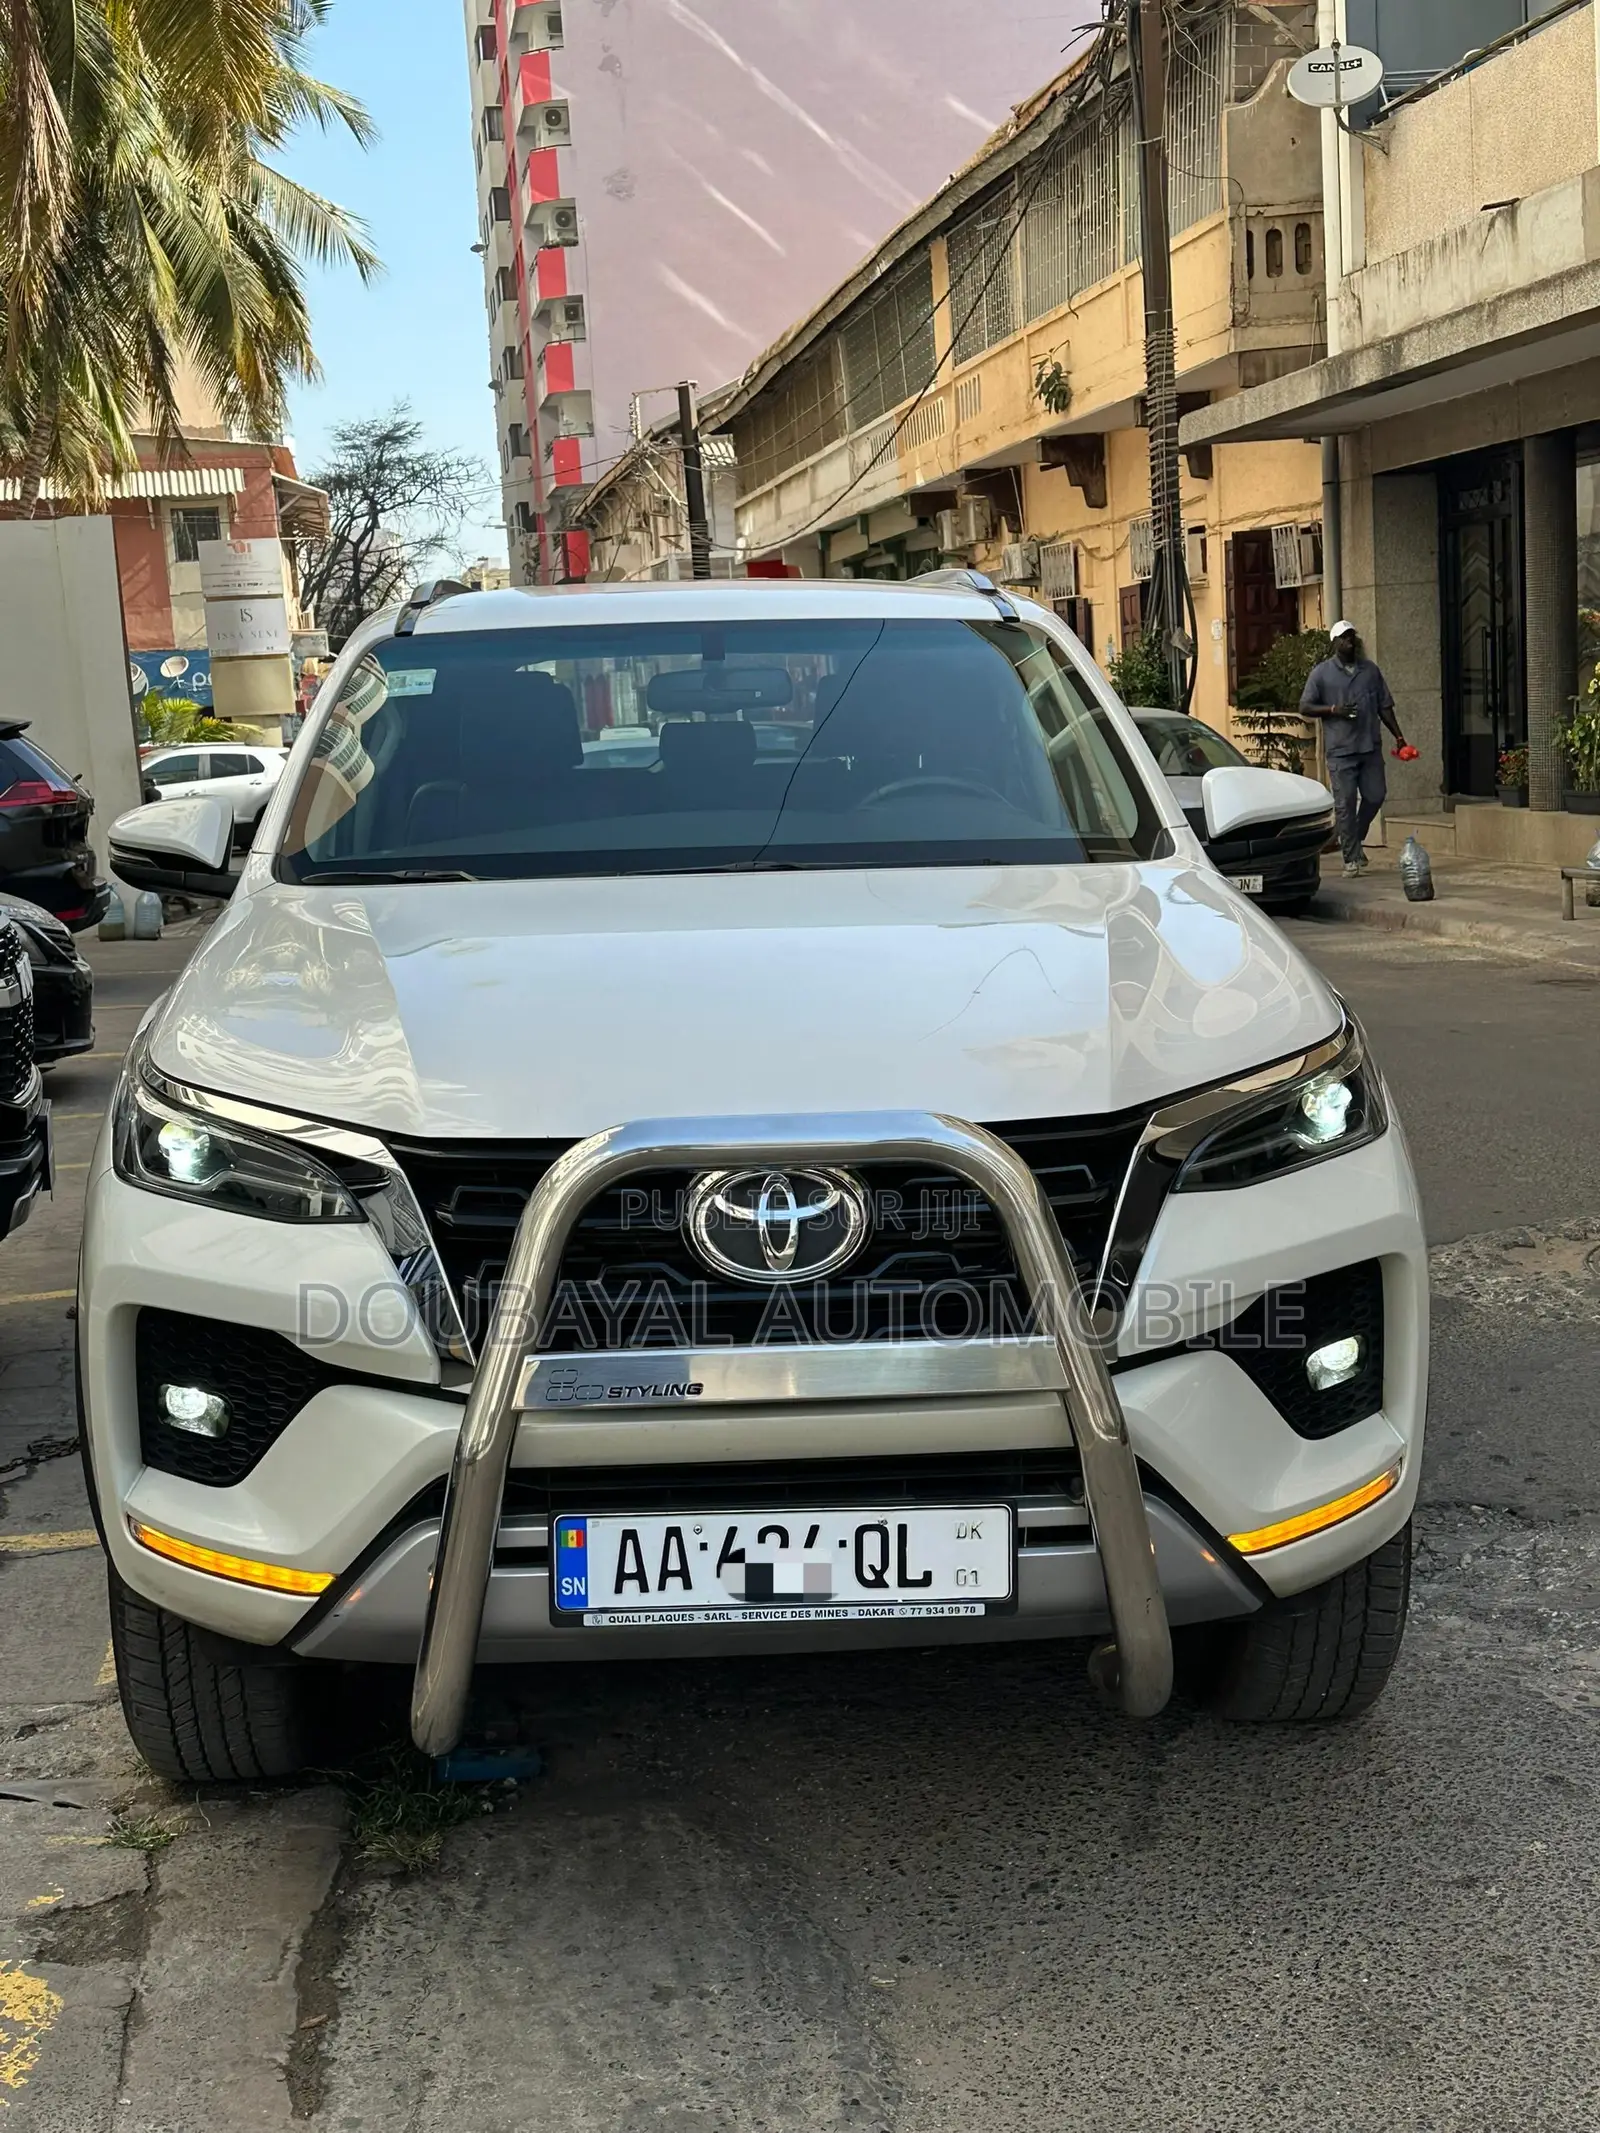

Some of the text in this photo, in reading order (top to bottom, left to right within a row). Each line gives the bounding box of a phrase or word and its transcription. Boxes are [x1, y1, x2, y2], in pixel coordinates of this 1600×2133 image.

[1309, 59, 1361, 72] CANAL+
[607, 1383, 704, 1399] STYLING
[956, 1521, 983, 1539] DK
[561, 1577, 586, 1596] SN
[608, 1614, 641, 1624] QUALI
[645, 1613, 695, 1623] PLAQUES
[703, 1612, 732, 1621] SARL
[741, 1610, 788, 1620] SERVICE
[790, 1609, 811, 1619] DES
[814, 1608, 849, 1618] MINES
[858, 1607, 894, 1617] DAKAR
[910, 1607, 922, 1615] 77
[926, 1606, 945, 1615] 934
